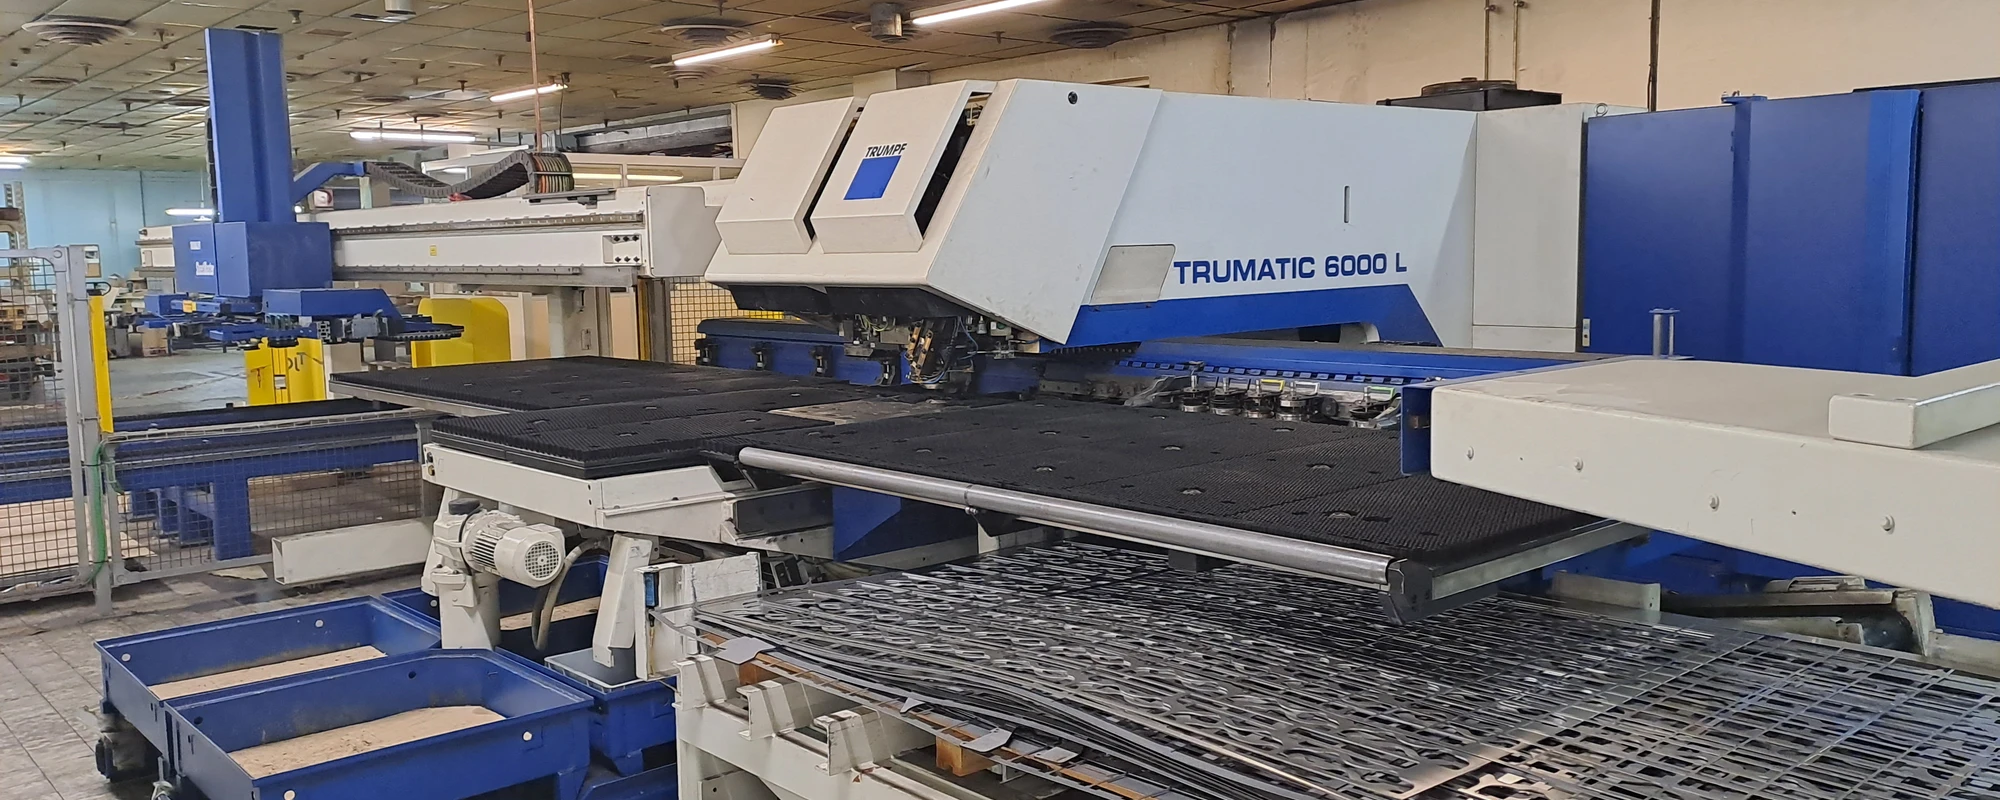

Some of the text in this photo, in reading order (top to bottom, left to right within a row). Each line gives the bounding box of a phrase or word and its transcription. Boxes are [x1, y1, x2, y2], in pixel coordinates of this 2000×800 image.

[865, 143, 907, 157] TRUMPF
[1173, 252, 1408, 284] TRUMATIC 6000 L
